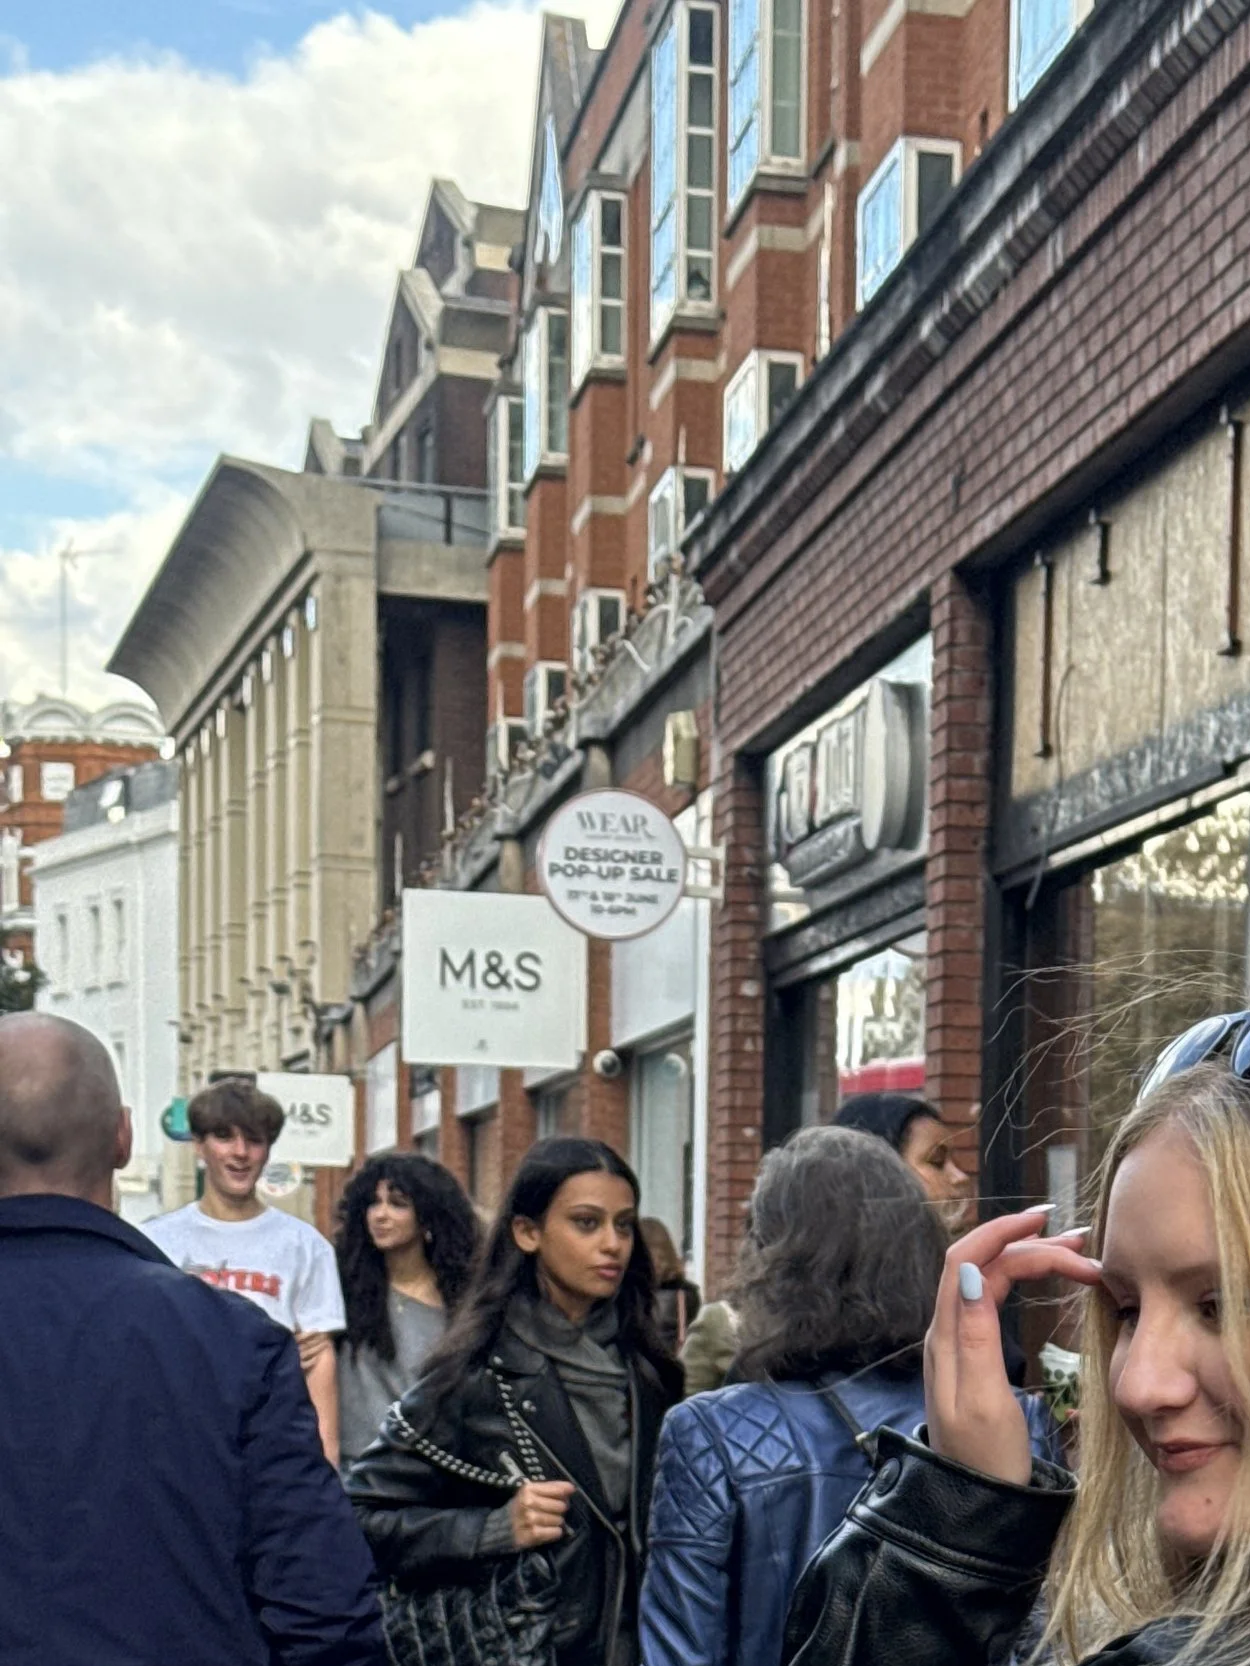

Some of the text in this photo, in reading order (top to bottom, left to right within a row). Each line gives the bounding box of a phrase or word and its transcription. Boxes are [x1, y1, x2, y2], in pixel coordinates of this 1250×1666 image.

[577, 811, 656, 839] WEAR
[564, 846, 663, 865] DESIGNER
[548, 862, 679, 883] POP-UP SALE
[440, 947, 542, 992] M&S
